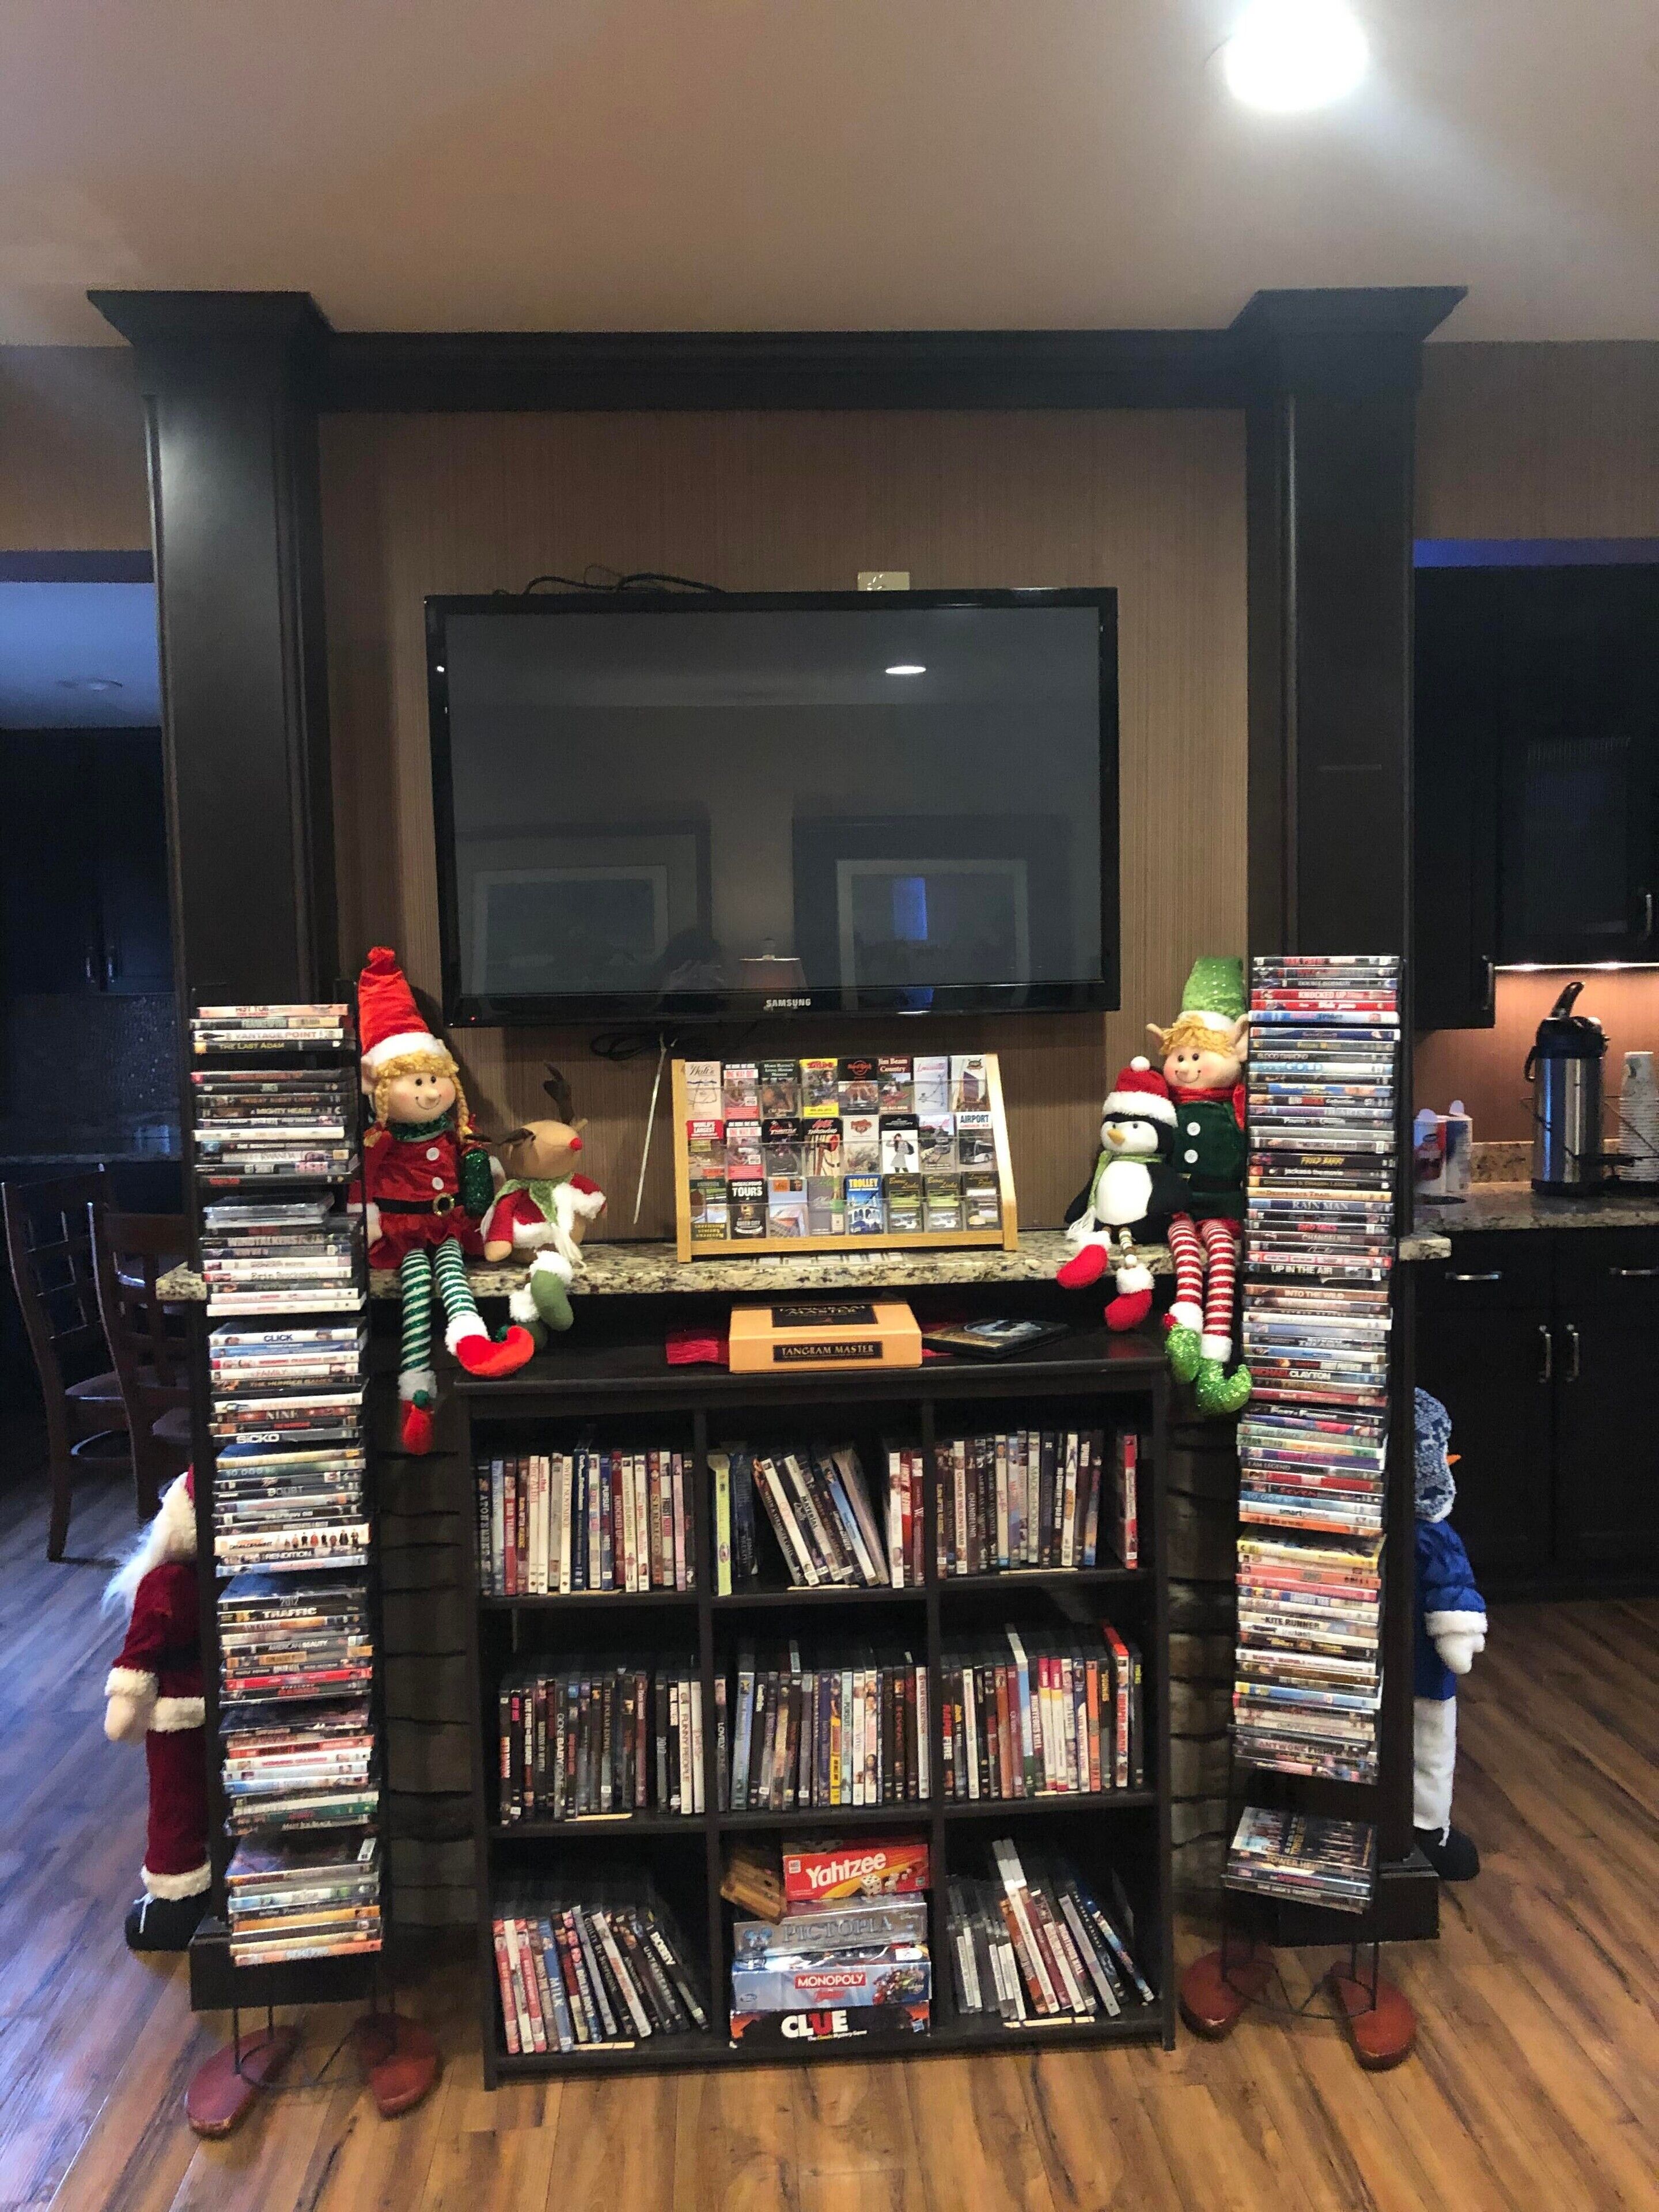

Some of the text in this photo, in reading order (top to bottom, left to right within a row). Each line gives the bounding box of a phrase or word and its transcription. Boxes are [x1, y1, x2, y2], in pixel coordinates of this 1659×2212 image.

[766, 998, 811, 1007] SAMSUNG
[960, 1114, 988, 1123] AIRPORT
[732, 1187, 763, 1196] TOURS
[1292, 1200, 1319, 1210] RAIN
[263, 1334, 293, 1342] CLICK
[782, 1344, 874, 1355] TANGRAM MASTER
[1289, 1370, 1331, 1380] CLAYTON
[968, 1493, 976, 1538] CHANGELING
[262, 1607, 317, 1618] TRAFFIC
[1265, 1617, 1283, 1625] KITE
[717, 1722, 725, 1749] LOVELY
[943, 1737, 952, 1760] FIRE
[806, 1853, 886, 1889] Yahtzee
[797, 1974, 863, 1986] MONOPOLY
[550, 1978, 564, 2007] MILK
[781, 2010, 849, 2037] CLUE
